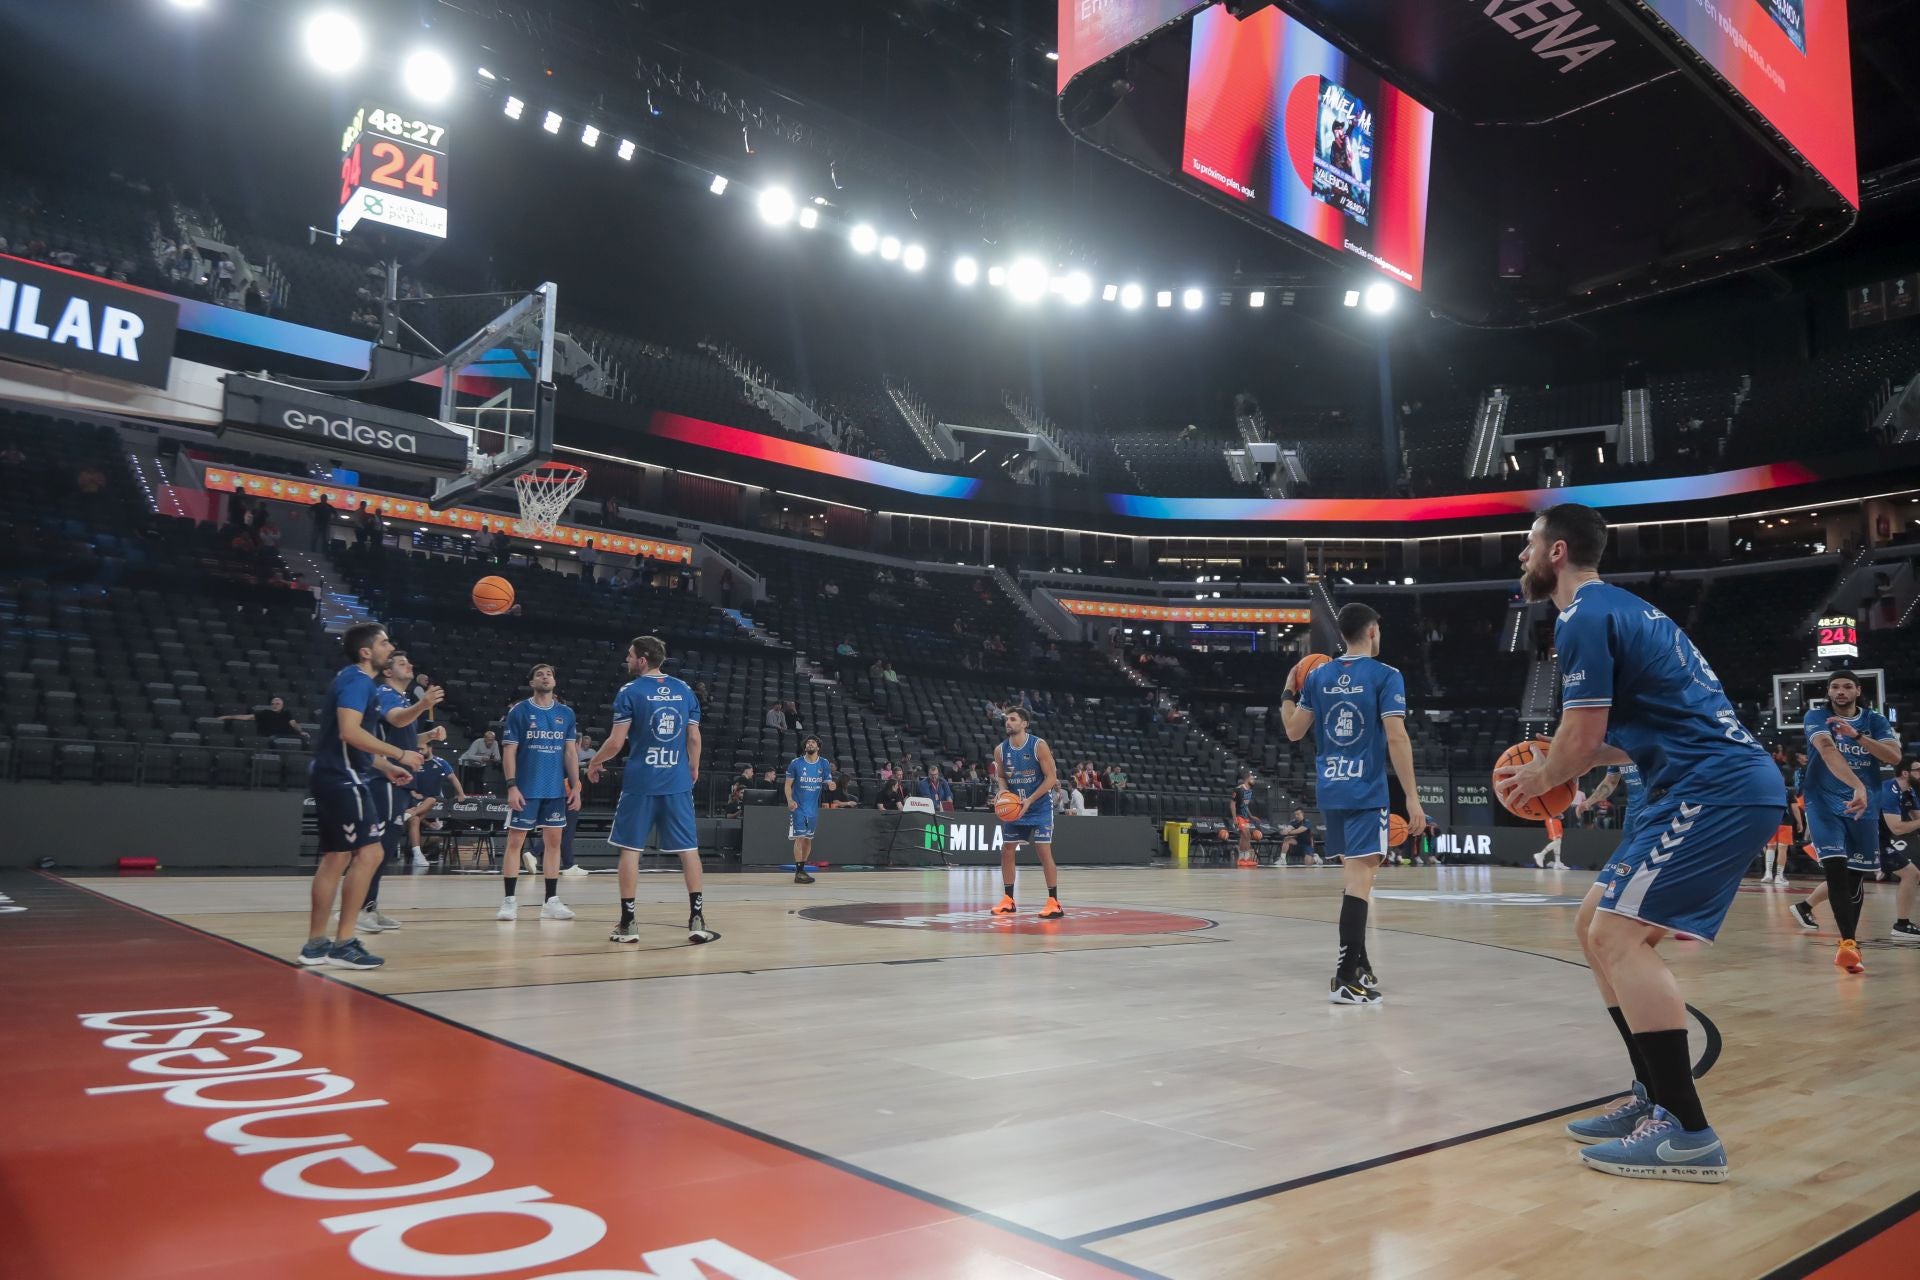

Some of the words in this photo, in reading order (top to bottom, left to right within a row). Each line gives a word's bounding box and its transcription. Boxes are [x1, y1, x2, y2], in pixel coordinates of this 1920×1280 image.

[1719, 12, 1786, 94] roigarena.com
[367, 108, 445, 146] 48:27
[371, 142, 439, 197] 24
[1193, 158, 1201, 170] Tu
[1315, 166, 1349, 194] VALENCIA
[0, 277, 145, 361] ILAR
[283, 409, 417, 454] endesa
[1818, 616, 1846, 626] 48:27
[1820, 627, 1846, 644] 24
[1323, 685, 1364, 694] LEXUS
[645, 746, 680, 766] atu
[1324, 755, 1364, 778] atu
[1457, 796, 1488, 805] SALIDA
[950, 824, 1021, 851] MILA
[1437, 833, 1491, 855] MILAR
